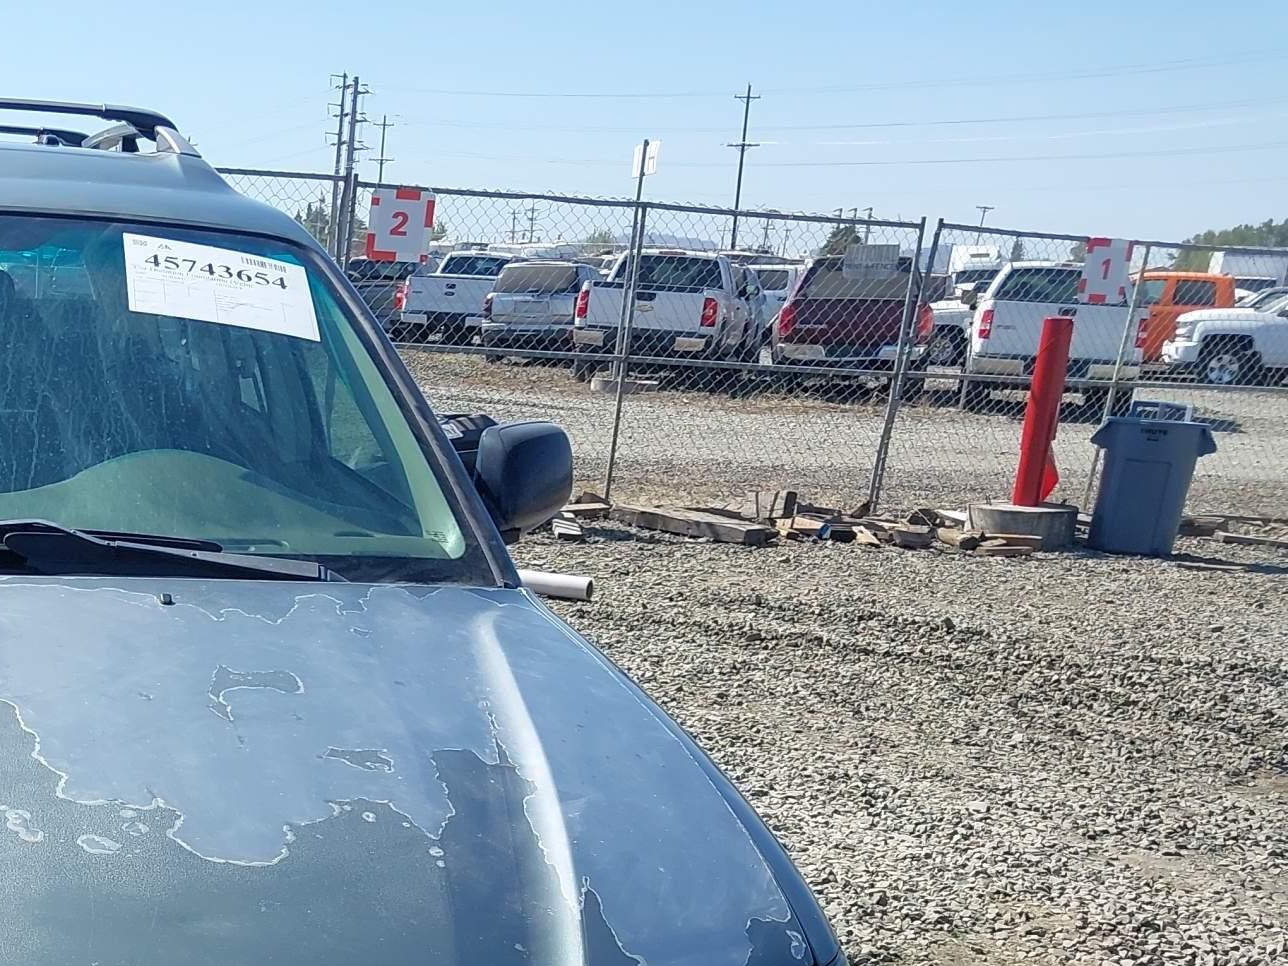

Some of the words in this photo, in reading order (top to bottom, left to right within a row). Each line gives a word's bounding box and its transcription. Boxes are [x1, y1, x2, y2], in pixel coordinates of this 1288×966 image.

[389, 211, 409, 237] 2
[144, 254, 288, 290] 45743654
[1101, 258, 1112, 281] 1
